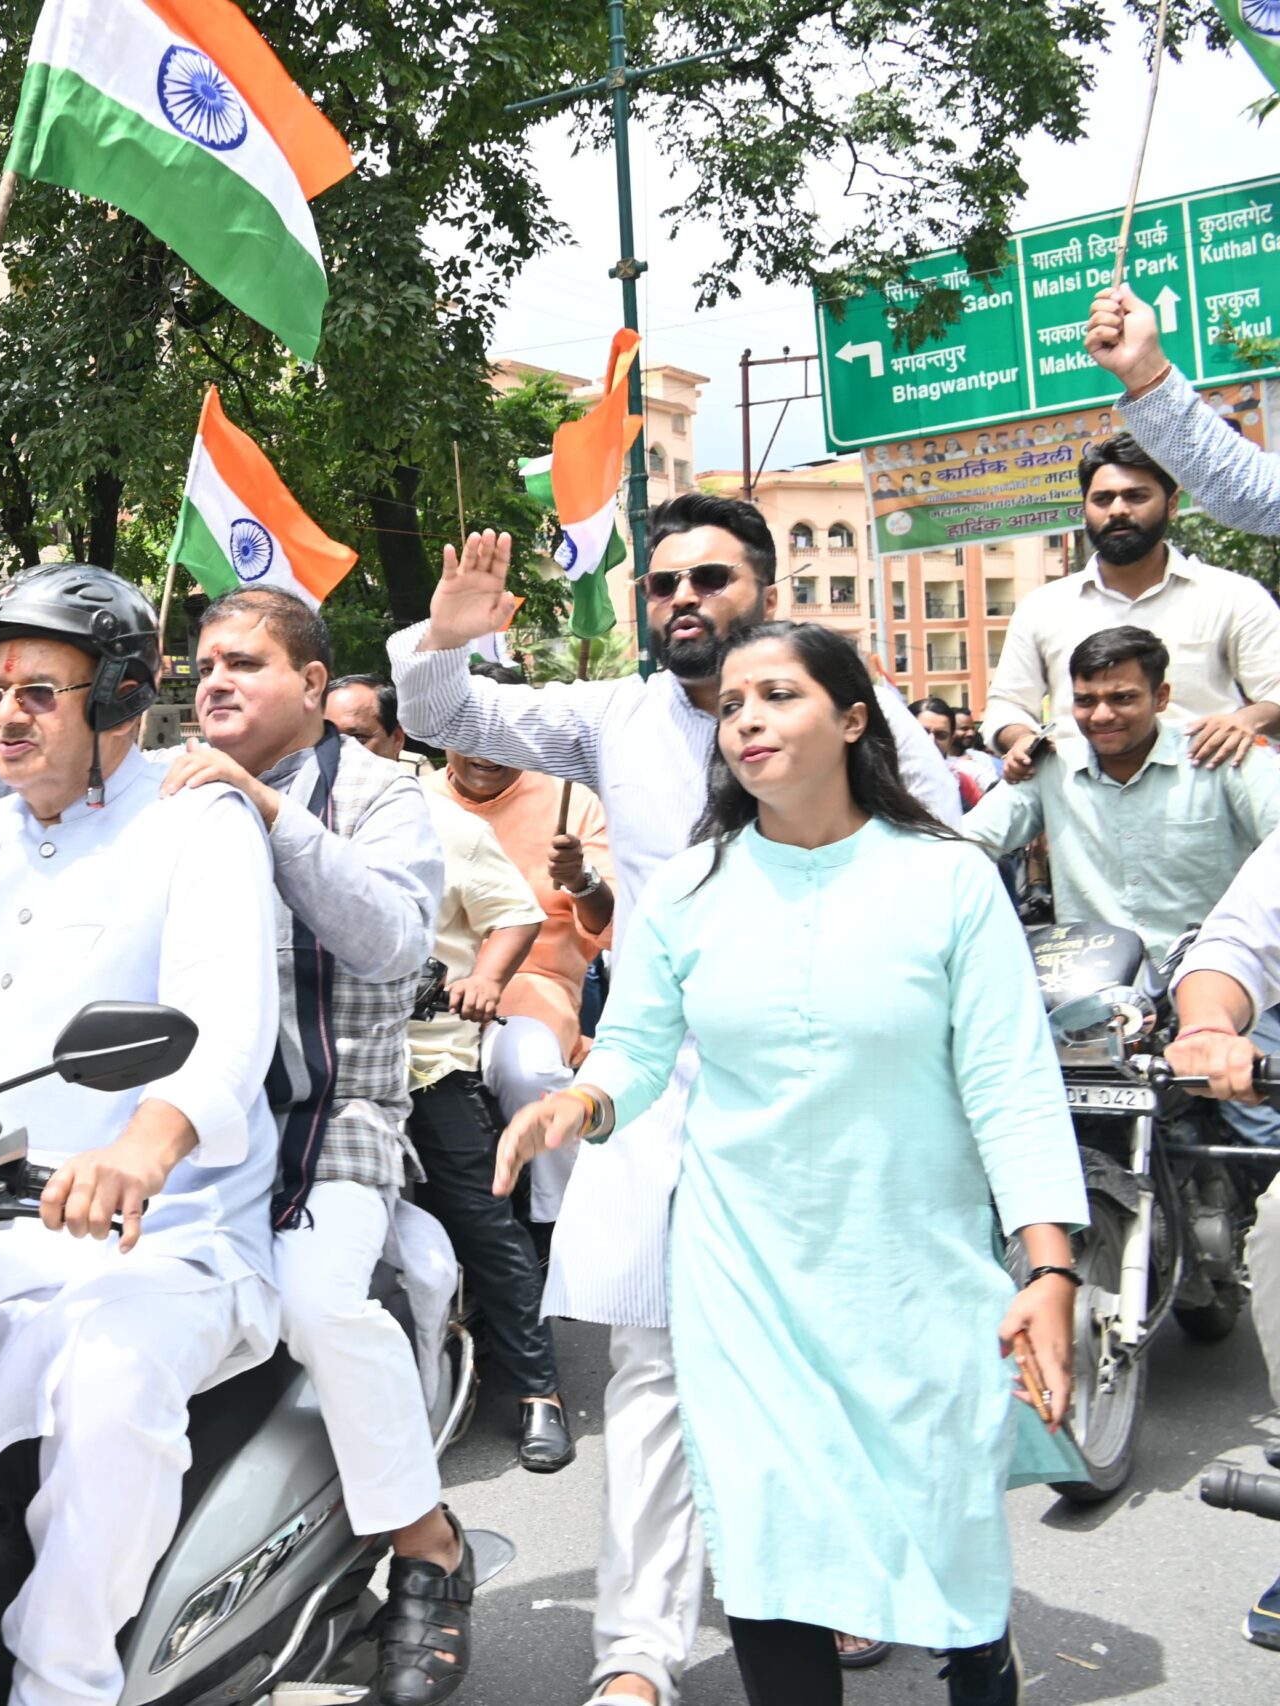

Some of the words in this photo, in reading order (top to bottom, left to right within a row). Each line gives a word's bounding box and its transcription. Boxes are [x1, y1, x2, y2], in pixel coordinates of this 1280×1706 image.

[1197, 200, 1273, 243] कुठालगेट
[1031, 238, 1083, 270] मालसी
[1087, 233, 1129, 260] डिय
[1134, 220, 1168, 249] पार्क
[1200, 236, 1257, 265] Kuthal
[1033, 272, 1082, 298] Malsi
[1135, 253, 1179, 278] Park
[961, 291, 1013, 313] Gaon
[1204, 287, 1260, 323] पुरकुल
[1207, 315, 1272, 345] Prkul
[890, 344, 967, 376] भगवन्तपुर
[892, 366, 1019, 403] Bhagwantpur
[936, 458, 1008, 483] कार्तिक
[1014, 445, 1073, 469] जेटली
[945, 515, 1002, 537] हार्दिक
[1007, 508, 1060, 528] आभार
[1098, 1089, 1147, 1107] 0421
